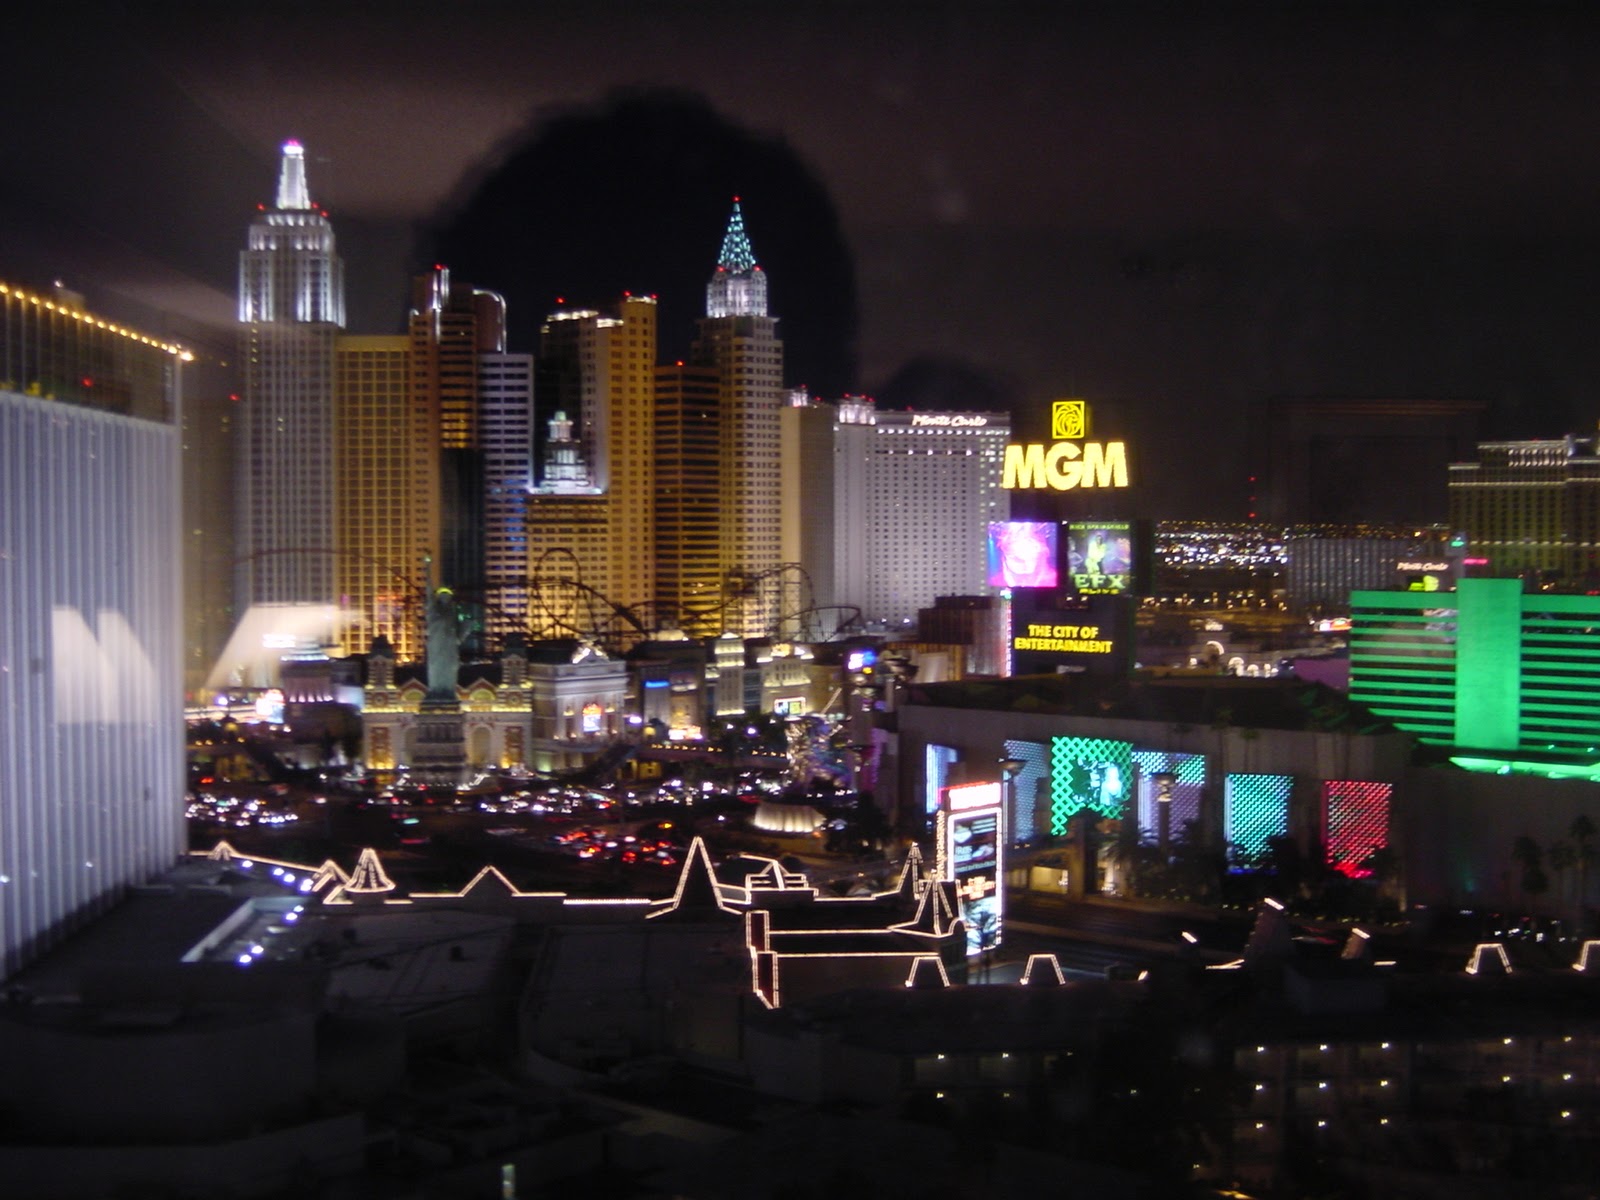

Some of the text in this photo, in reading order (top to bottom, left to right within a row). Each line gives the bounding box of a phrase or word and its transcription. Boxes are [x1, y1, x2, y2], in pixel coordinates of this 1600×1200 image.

[1002, 441, 1129, 491] MGM
[1074, 573, 1126, 590] EFX
[1027, 624, 1099, 640] THE CITY OF
[1014, 636, 1113, 654] ENTERTAINMENT
